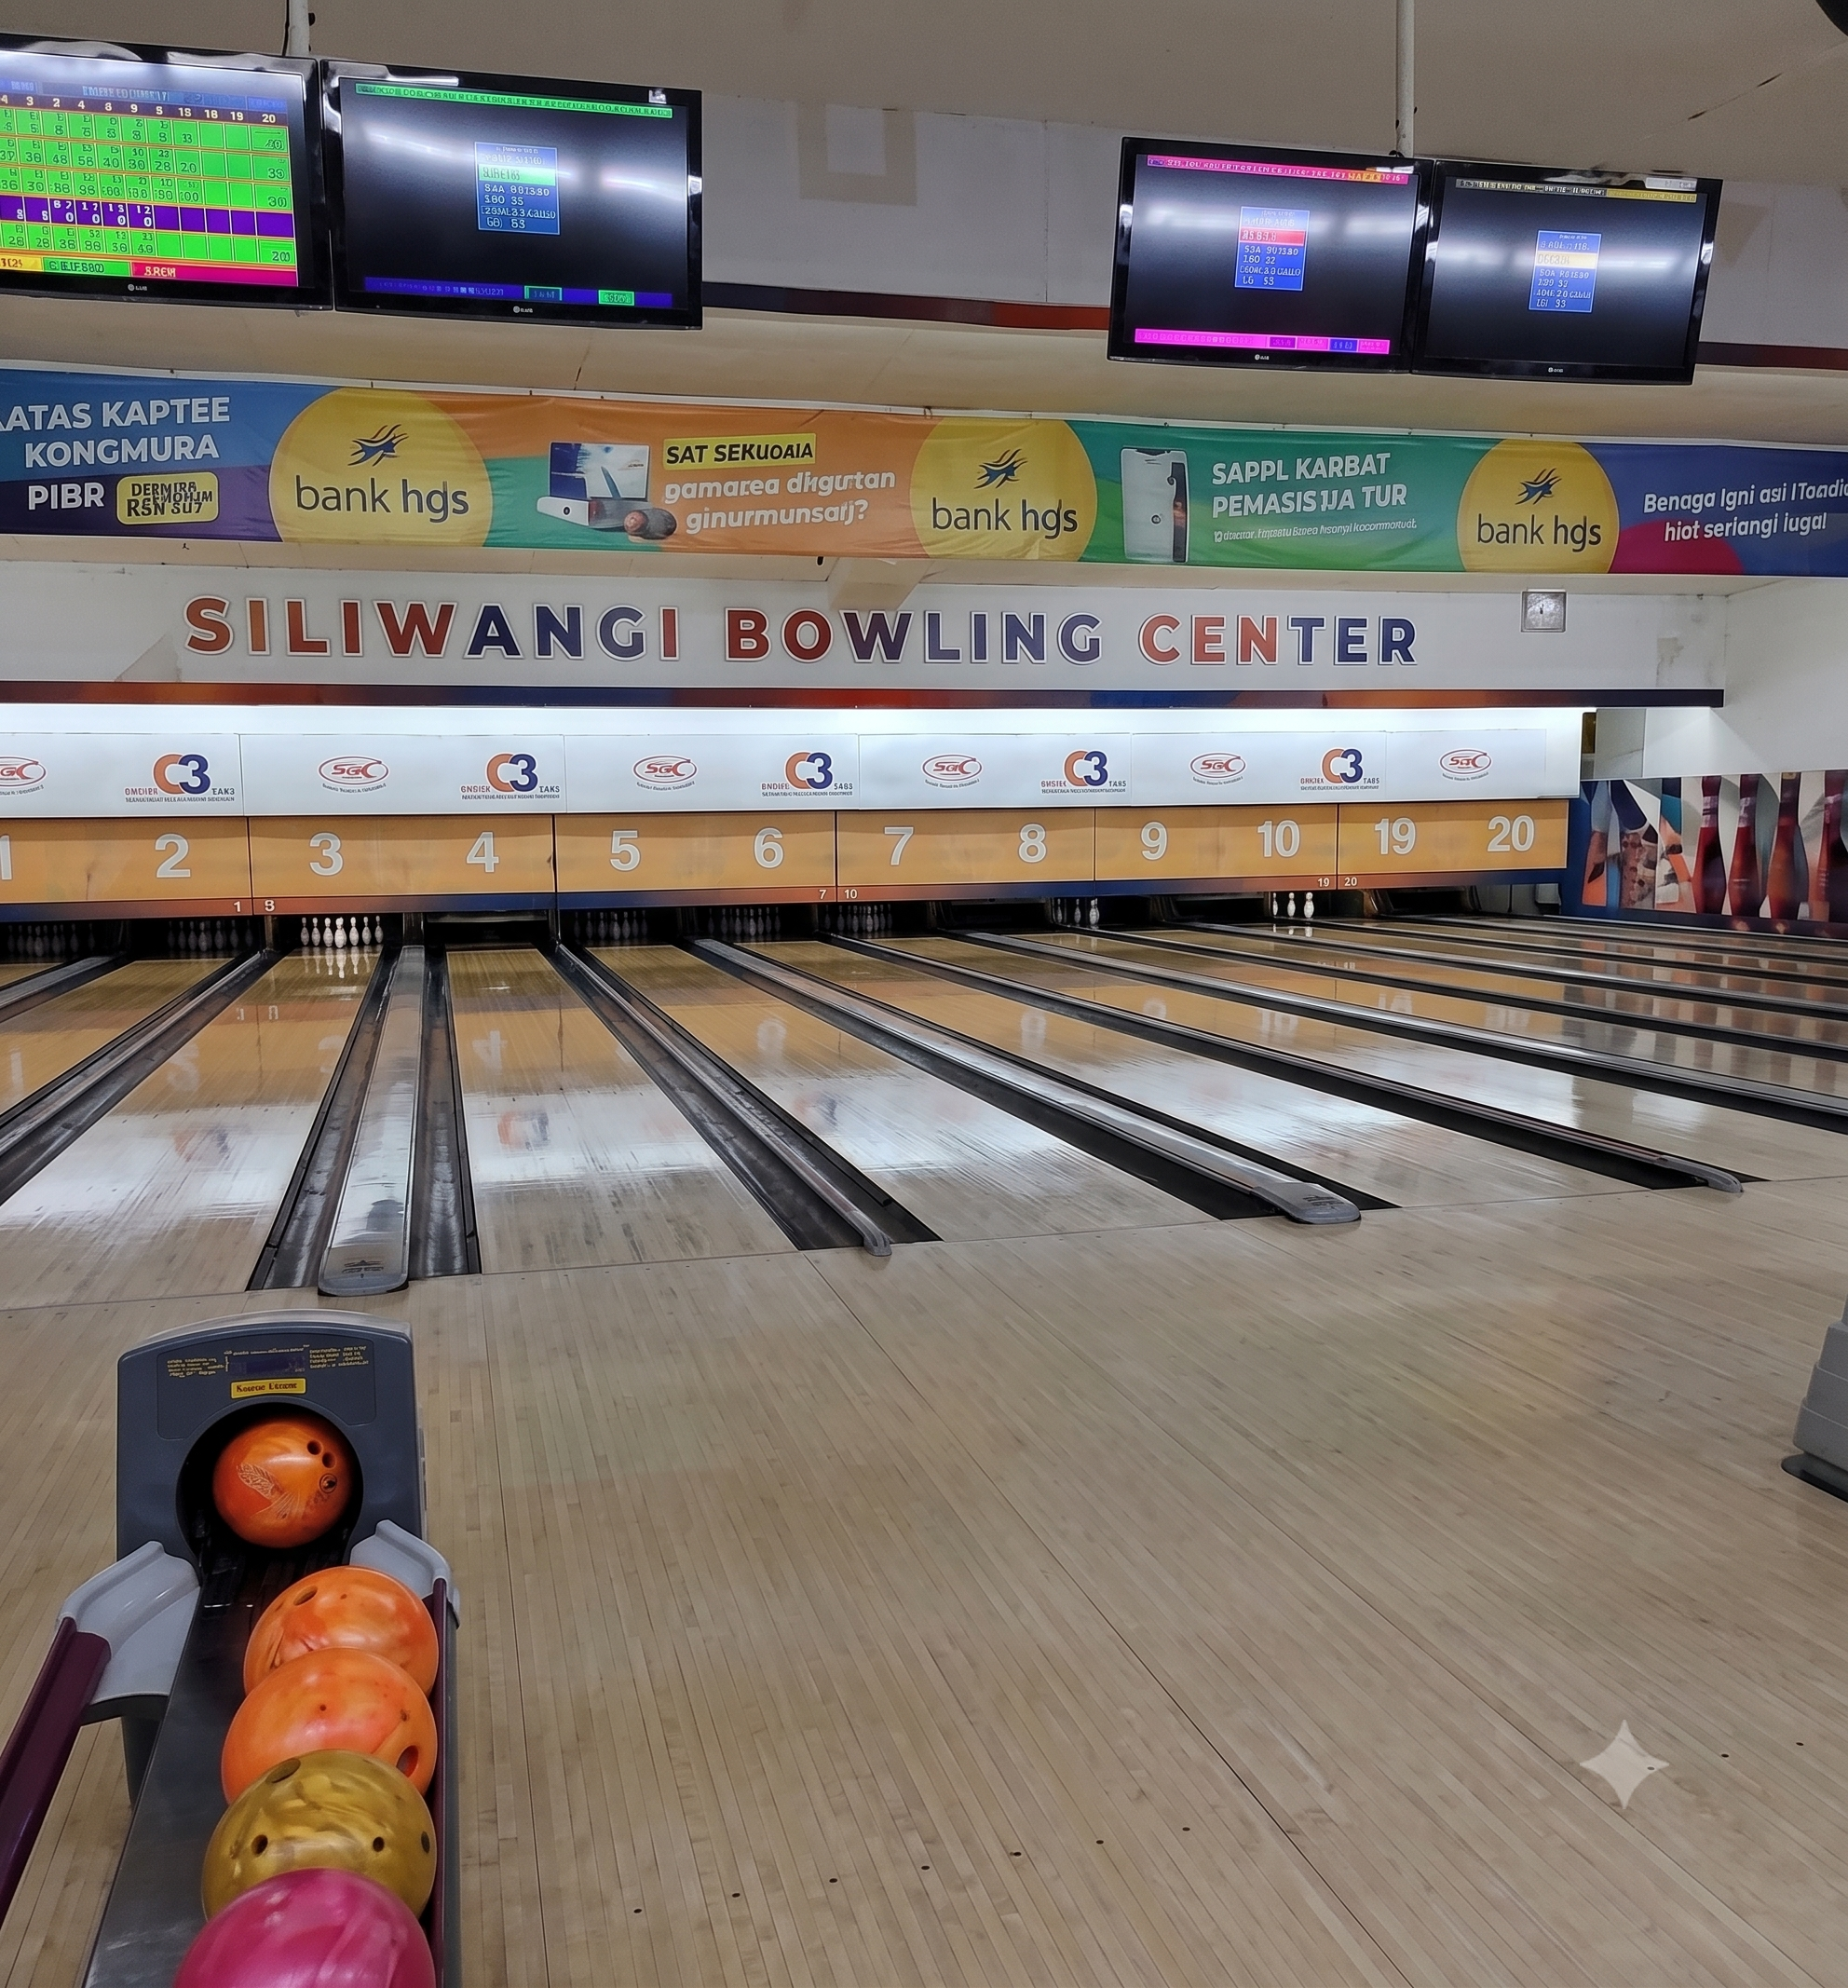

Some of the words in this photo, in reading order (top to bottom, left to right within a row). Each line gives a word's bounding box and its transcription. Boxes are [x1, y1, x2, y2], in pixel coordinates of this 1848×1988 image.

[0, 402, 92, 432] ATAS
[102, 397, 230, 428] KAPTEE
[25, 434, 220, 469] KONGMURA
[666, 445, 708, 464] SAT
[1212, 459, 1289, 485] SAPPL
[1295, 453, 1391, 480] KARBAT
[28, 482, 105, 511] PIBR
[295, 474, 391, 513] bank
[401, 478, 469, 523] hgs
[1361, 483, 1407, 508] TUR
[1643, 492, 1716, 513] Benaga
[932, 497, 1012, 531] bank
[1021, 498, 1079, 540] hgs
[1477, 512, 1545, 545] bank
[1553, 514, 1602, 552] hgs
[184, 597, 681, 660] SILIWANGI
[725, 606, 1103, 665] BOWLING
[1138, 613, 1419, 667] CENTER
[153, 754, 211, 795] C3
[486, 753, 538, 793] C3
[785, 751, 833, 790] C3
[1064, 750, 1108, 786] C3
[1322, 748, 1364, 783] C3
[466, 831, 499, 874] 4
[609, 829, 642, 872] 5
[753, 826, 785, 869] 6
[883, 825, 915, 866] 7
[1018, 823, 1048, 864] 8
[1140, 821, 1168, 861] 9
[1257, 819, 1301, 859] 10
[1374, 817, 1417, 855] 19
[1487, 815, 1536, 852] 20
[154, 834, 192, 878] 2
[308, 833, 344, 876] 3
[818, 889, 827, 900] 7
[844, 889, 859, 900] 10
[1344, 877, 1358, 887] 20
[233, 901, 241, 912] 1
